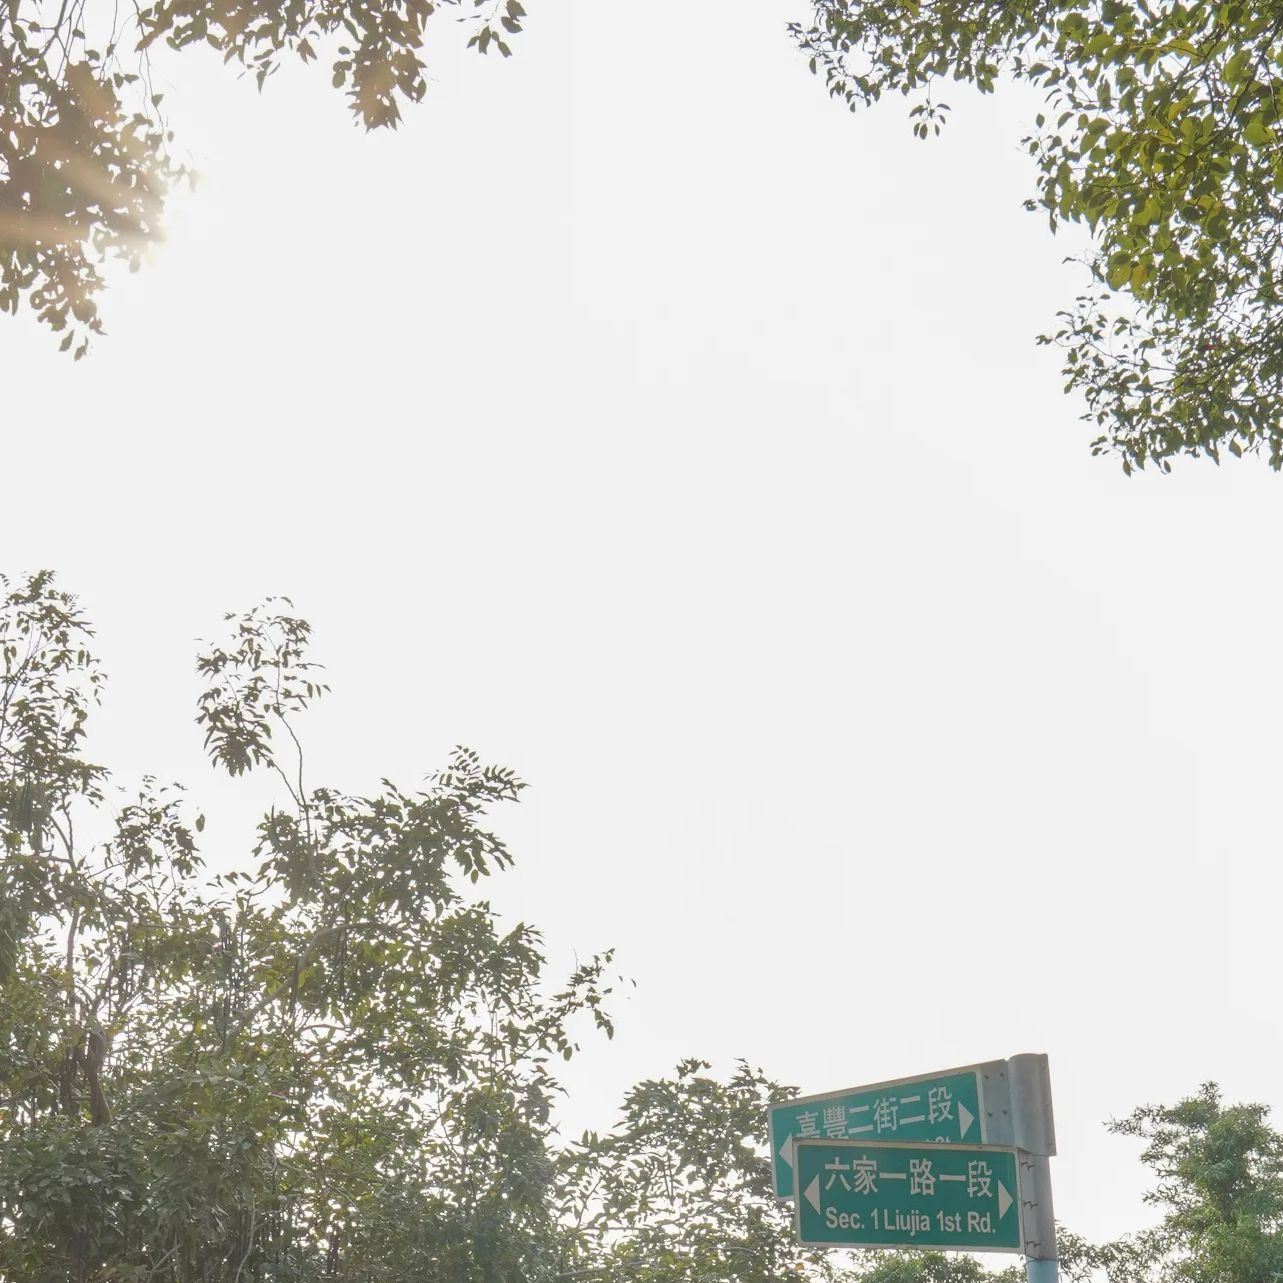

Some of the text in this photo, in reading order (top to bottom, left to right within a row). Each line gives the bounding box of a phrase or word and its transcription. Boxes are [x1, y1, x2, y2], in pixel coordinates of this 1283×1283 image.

[796, 1087, 954, 1139] 嘉豐二街二段
[824, 1155, 994, 1199] 六家一路一段
[825, 1206, 997, 1237] Sec. 1 Liujia 1st Rd.
